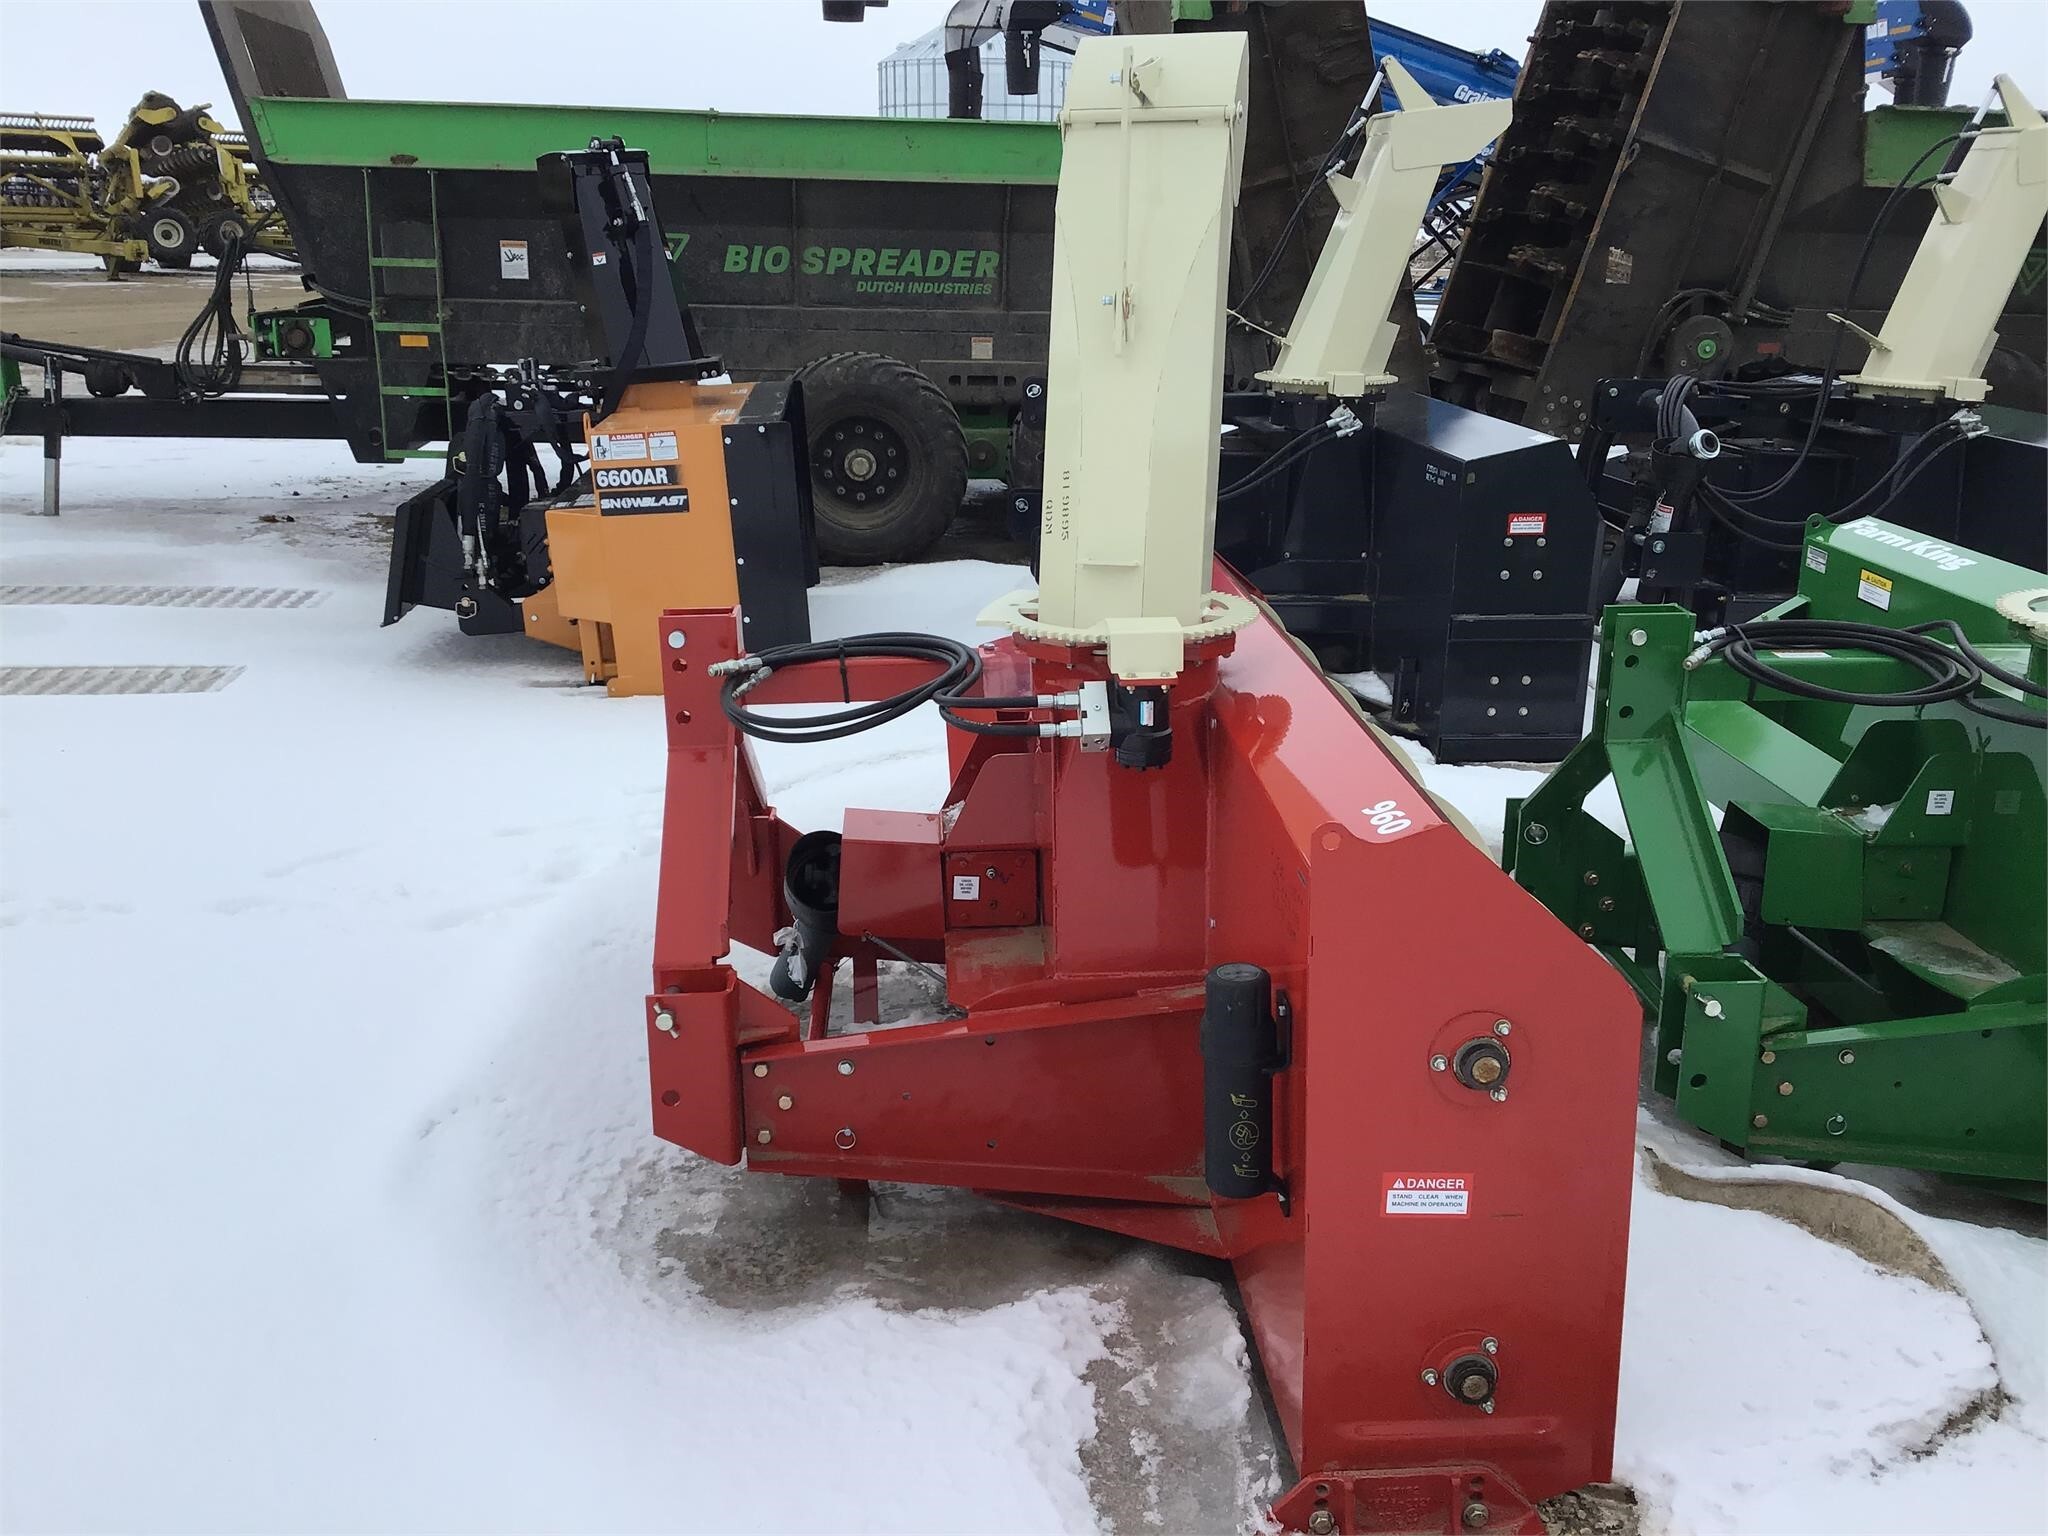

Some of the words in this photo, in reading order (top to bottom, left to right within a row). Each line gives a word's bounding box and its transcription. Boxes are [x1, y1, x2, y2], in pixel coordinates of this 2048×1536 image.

[723, 244, 791, 274] BIO
[800, 246, 1000, 278] SPREADER
[856, 281, 904, 293] DUTCH
[908, 282, 993, 295] INDUSTRIES
[596, 467, 668, 487] 6600AR
[600, 494, 687, 509] SNOWBLAST
[1840, 519, 1913, 548] Farm
[1902, 540, 1979, 571] King
[1360, 799, 1412, 835] 960
[1407, 1178, 1465, 1189] DANGER
